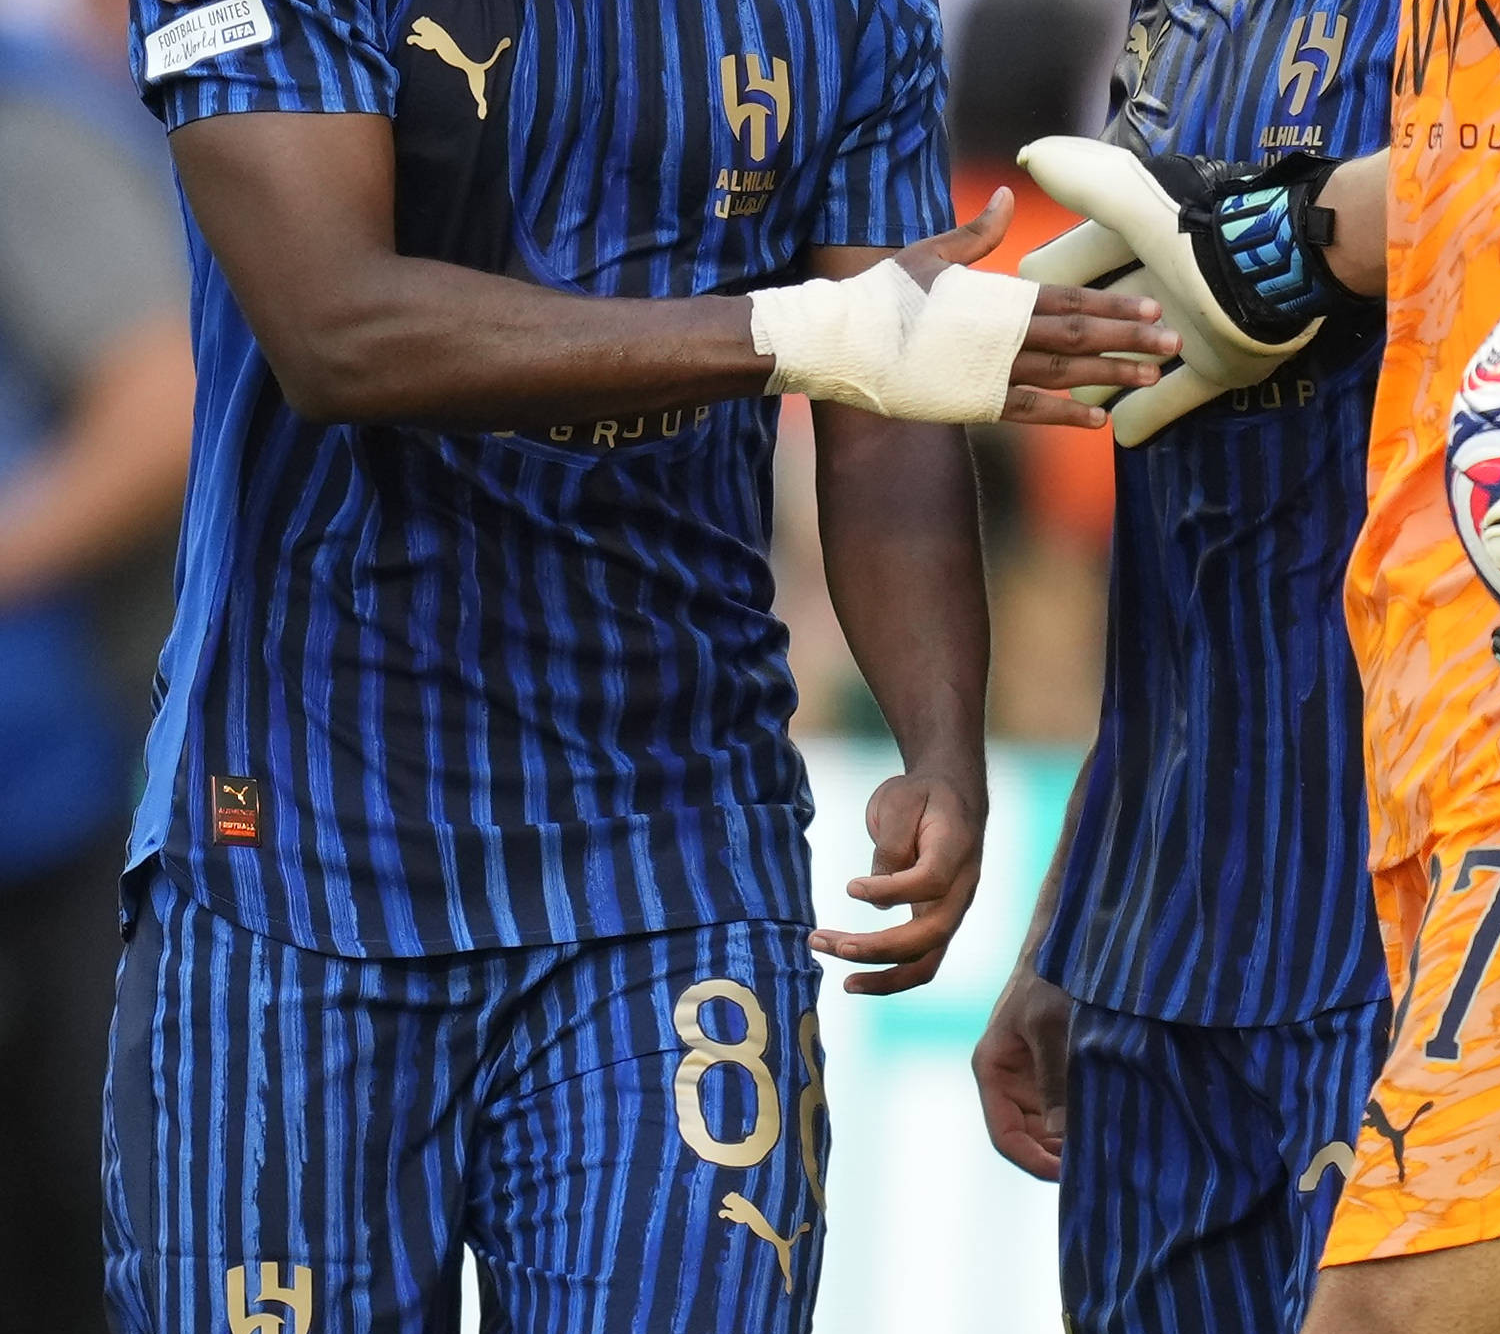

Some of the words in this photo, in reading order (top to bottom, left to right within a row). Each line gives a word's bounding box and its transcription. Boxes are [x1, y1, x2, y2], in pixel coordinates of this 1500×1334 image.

[158, 15, 206, 50] FOOTBALL
[207, 0, 251, 27] UNITES
[181, 29, 218, 61] World
[221, 20, 256, 44] FIFA
[1258, 125, 1324, 149] ALHILAL
[715, 168, 777, 192] ALHILAL
